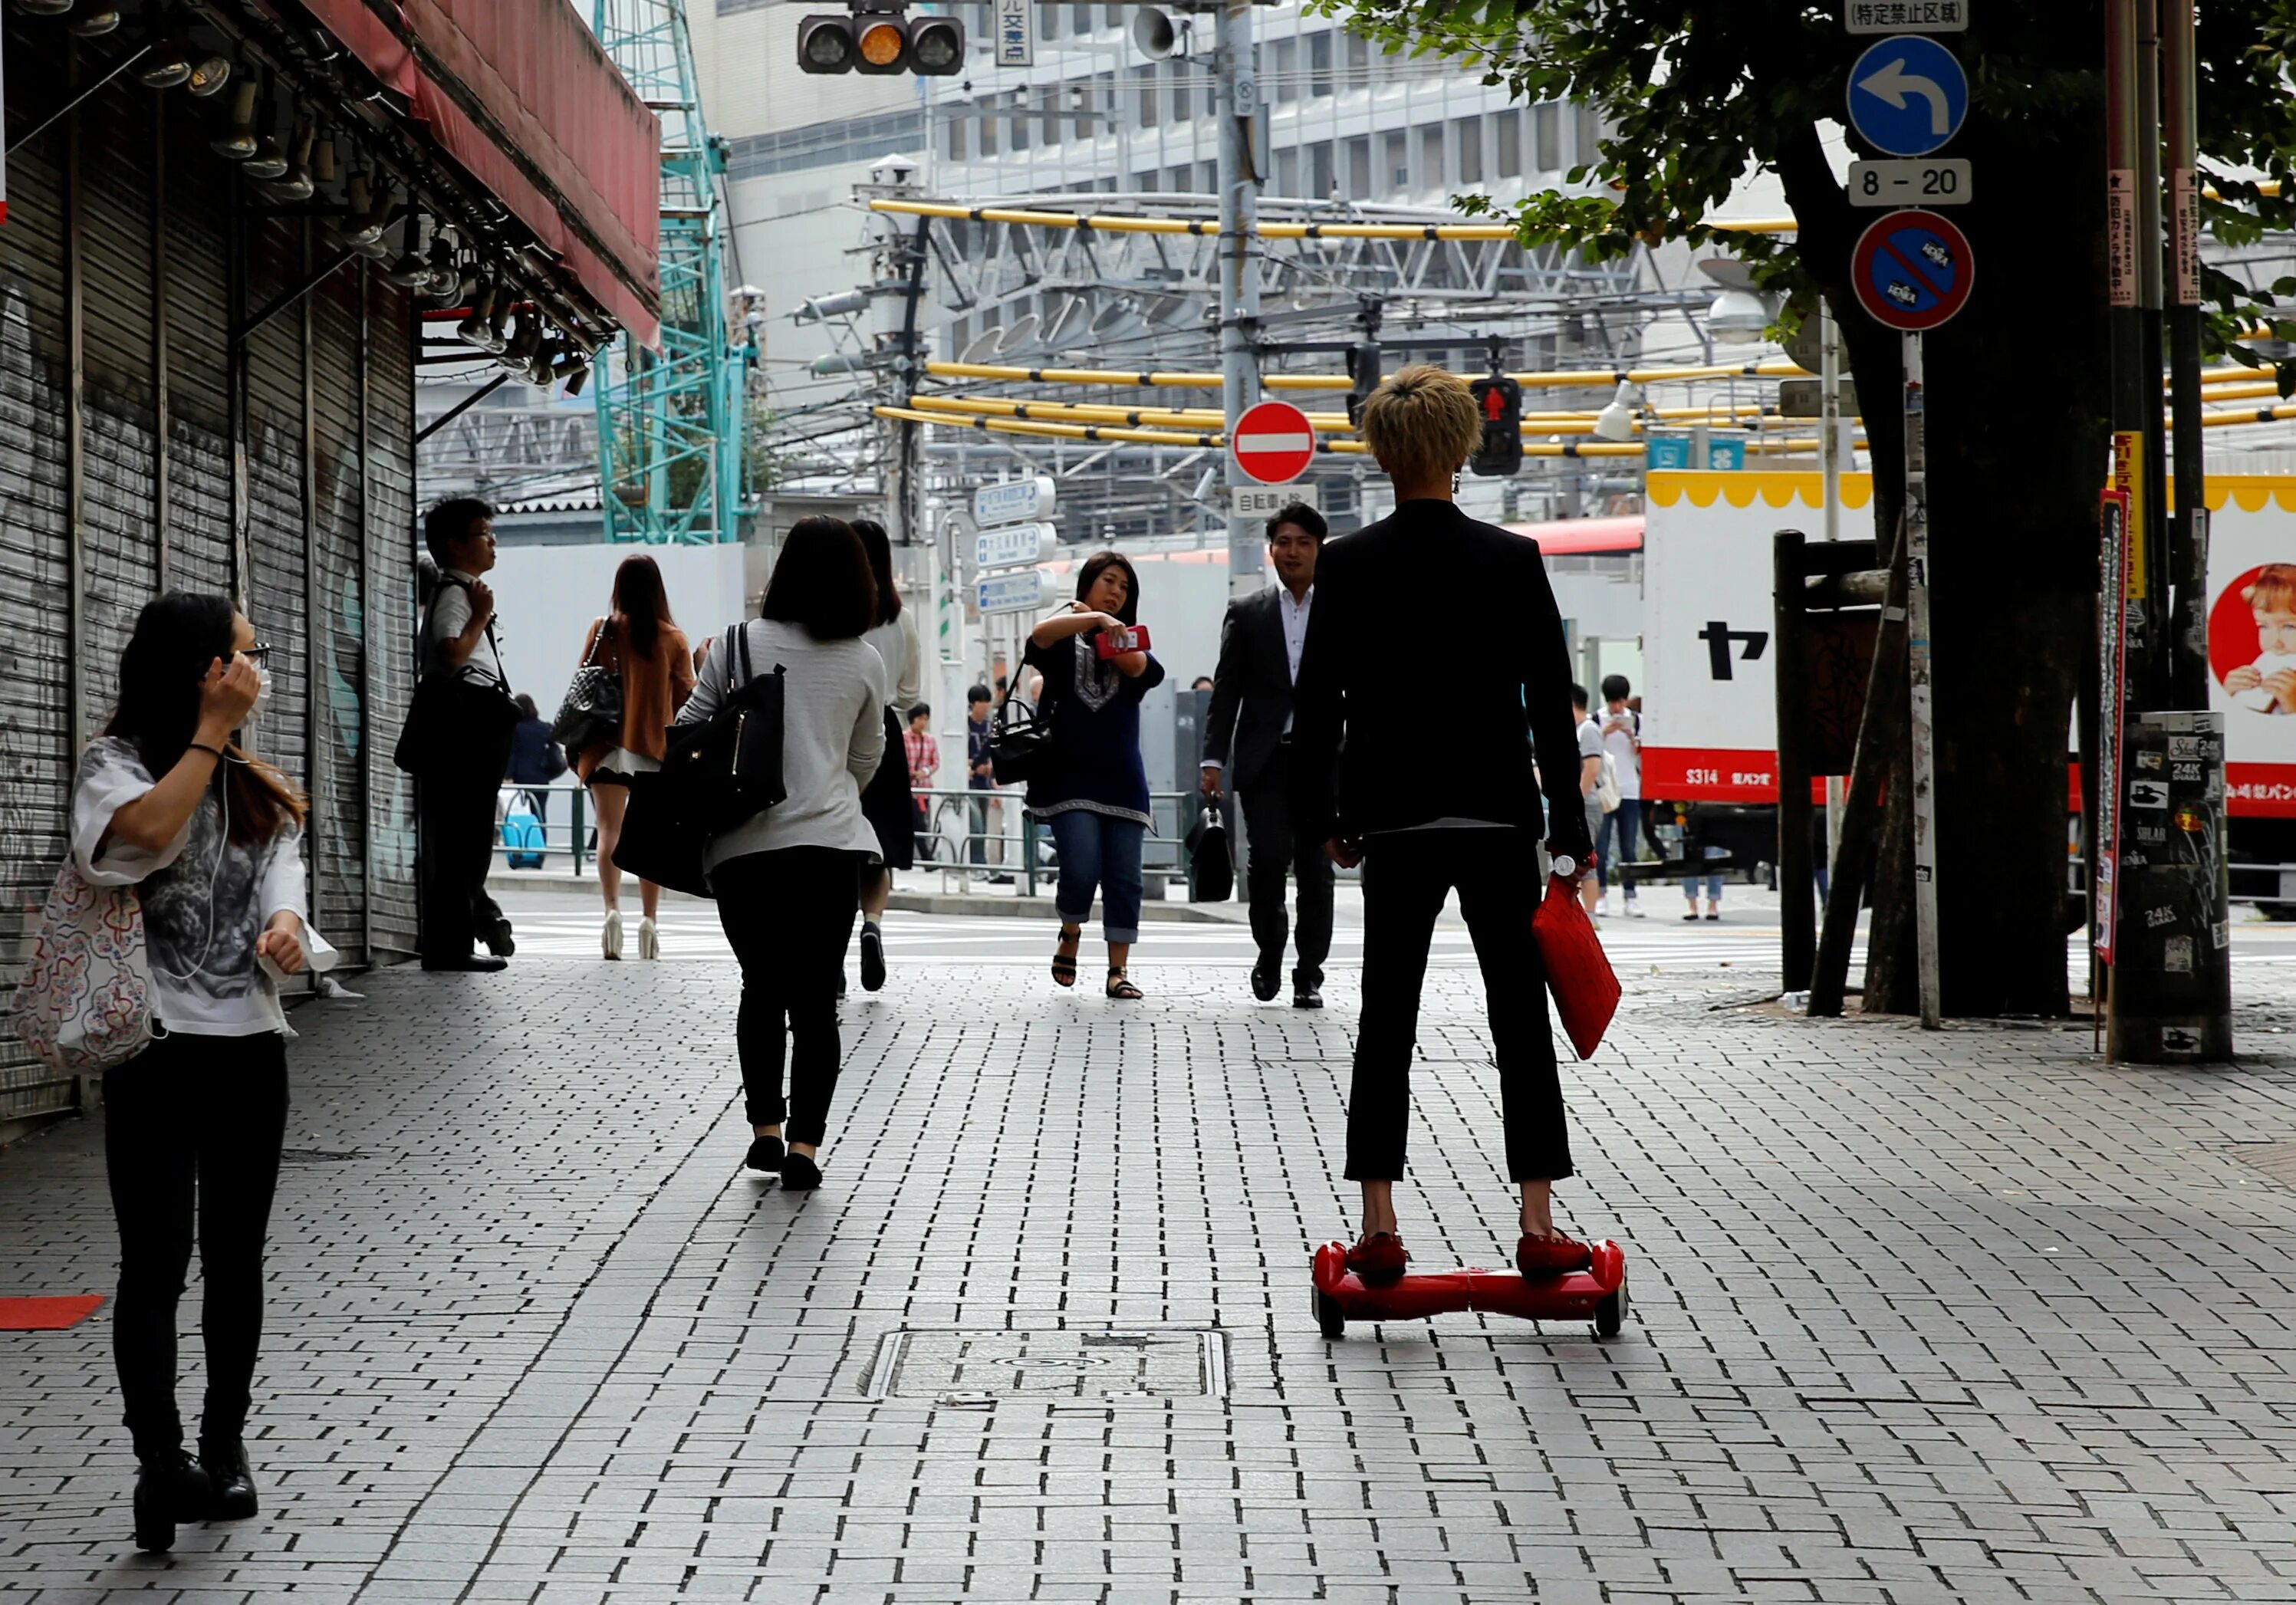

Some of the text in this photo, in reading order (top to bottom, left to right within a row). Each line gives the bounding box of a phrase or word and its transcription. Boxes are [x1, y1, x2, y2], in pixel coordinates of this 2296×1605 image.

[1863, 170, 1879, 196] 8
[1923, 169, 1956, 195] 20
[1698, 621, 1768, 680] ヤ
[1686, 768, 1719, 784] S314
[2173, 763, 2201, 774] 24K
